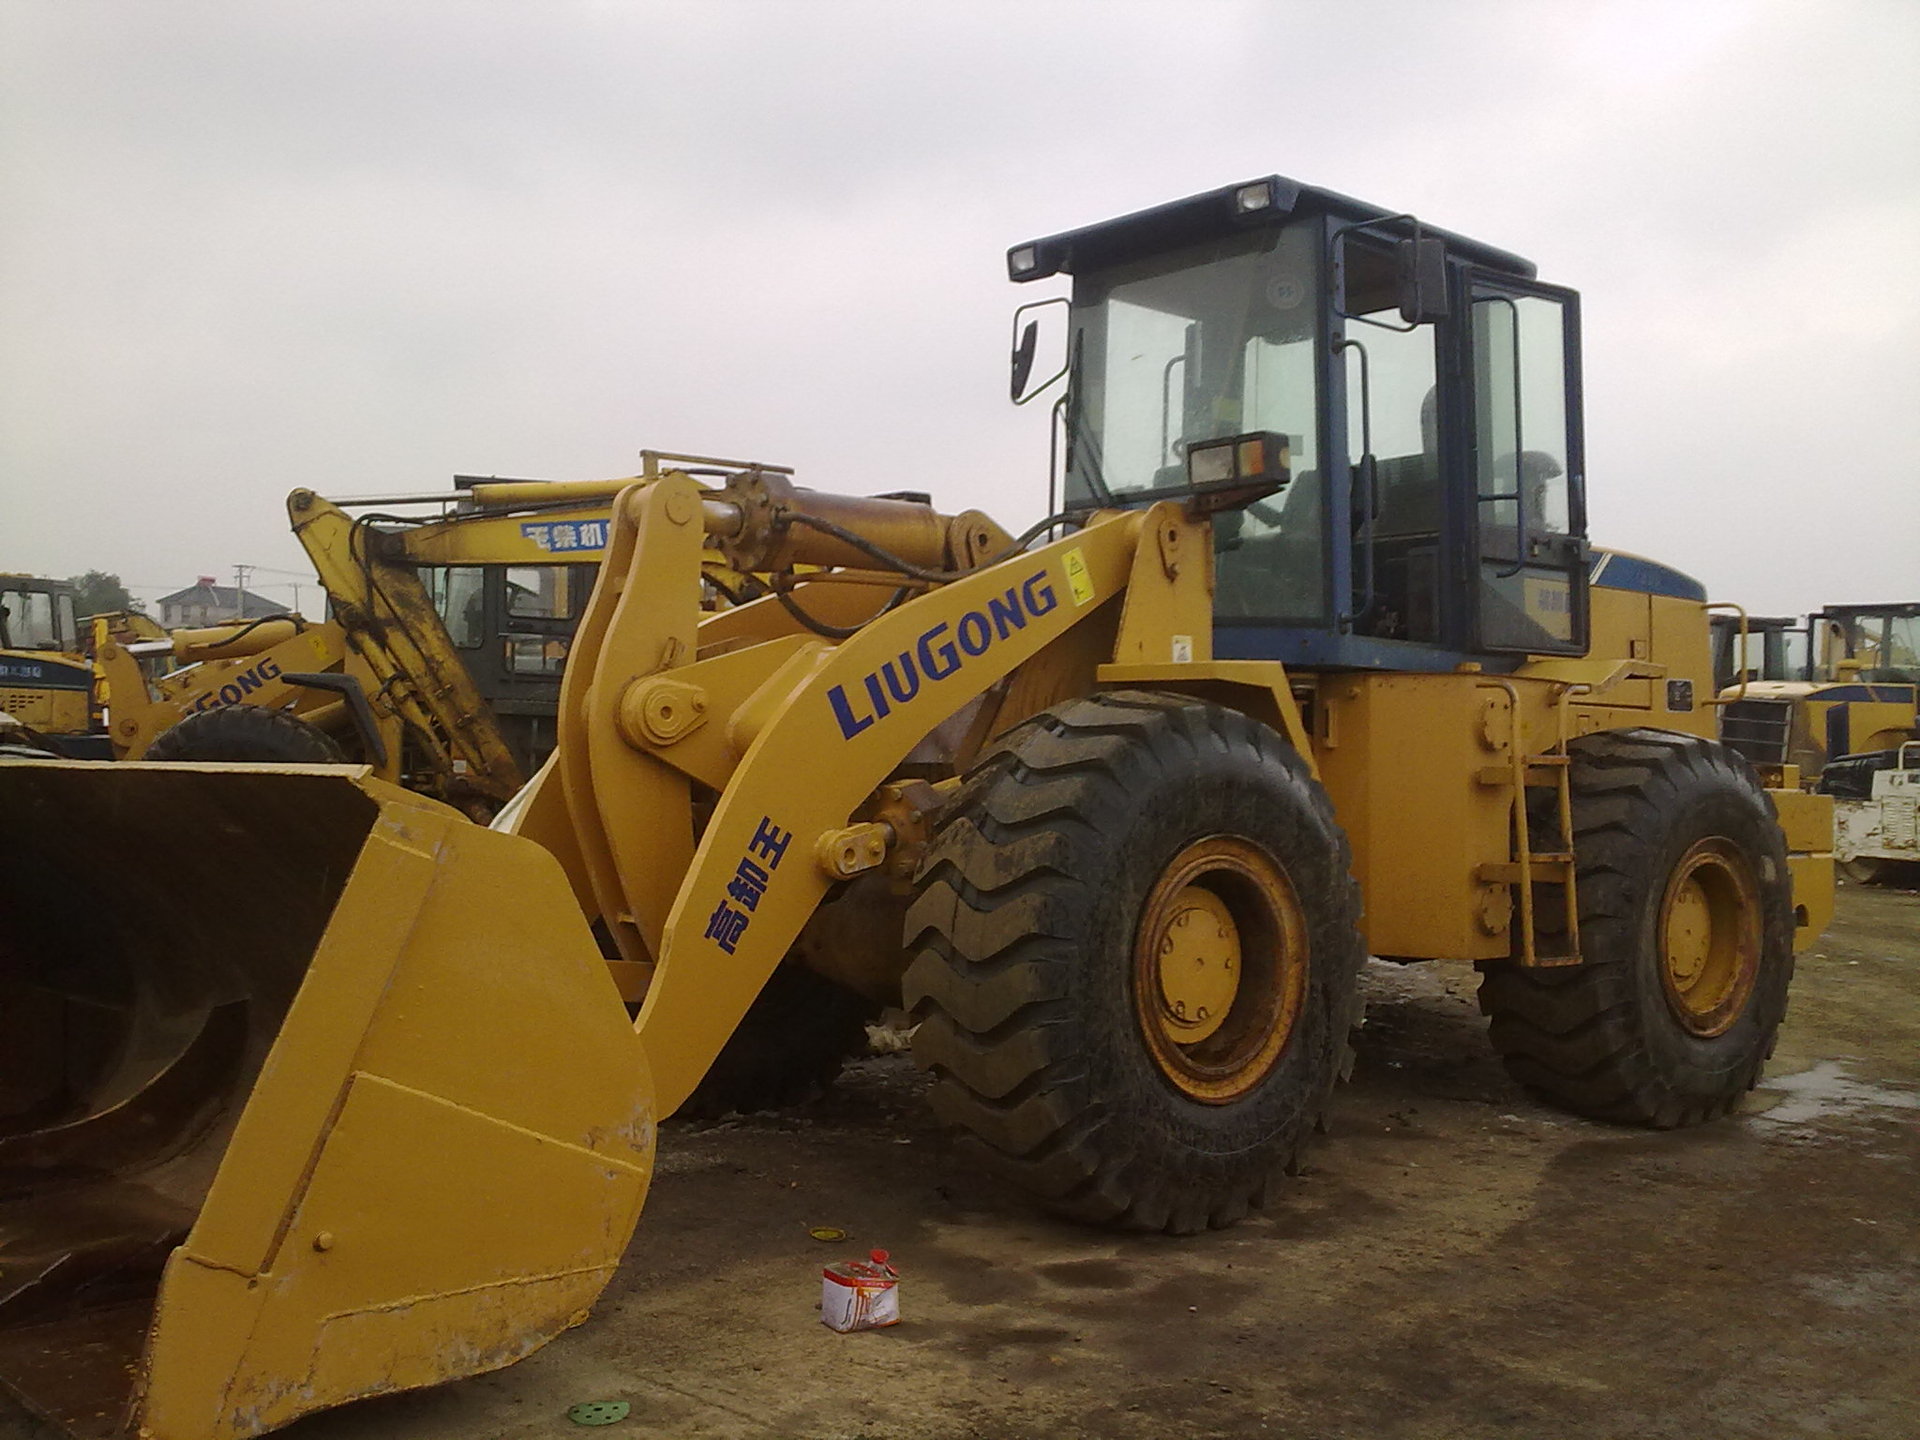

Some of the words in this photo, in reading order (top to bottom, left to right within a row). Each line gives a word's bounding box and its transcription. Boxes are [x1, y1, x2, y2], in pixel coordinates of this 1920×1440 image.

[526, 522, 611, 549] 玉柴机
[186, 657, 282, 716] GONG
[827, 569, 1058, 741] LIUGONG
[704, 815, 793, 956] 高卸王
